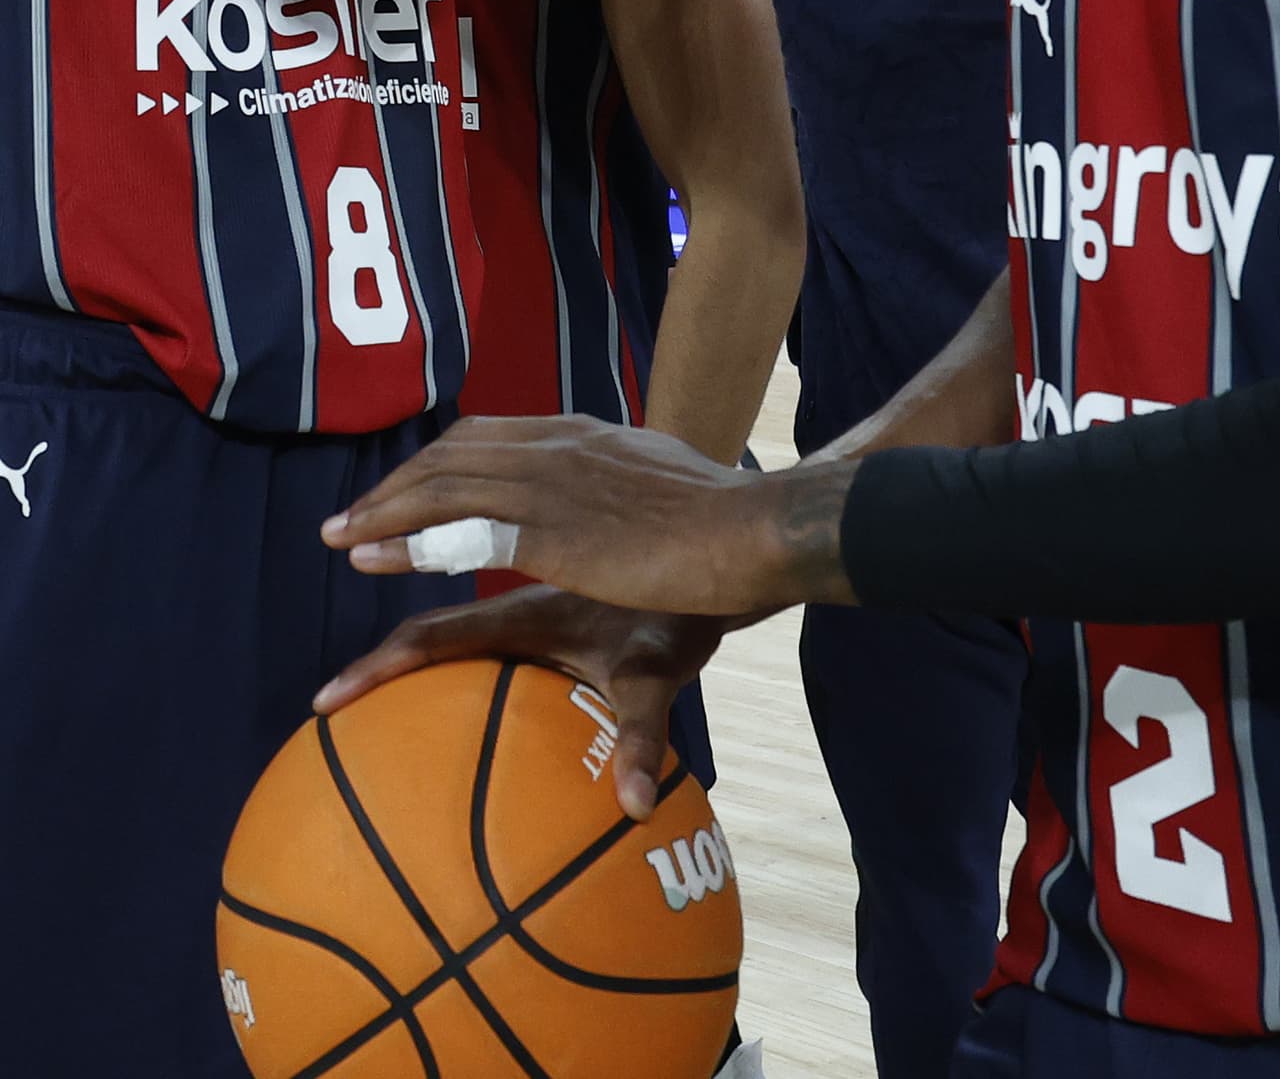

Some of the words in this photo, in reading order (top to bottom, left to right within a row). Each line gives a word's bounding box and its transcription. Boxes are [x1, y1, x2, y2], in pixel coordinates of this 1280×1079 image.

[375, 77, 450, 106] eficiente
[327, 166, 409, 346] 8
[1103, 664, 1233, 923] 2
